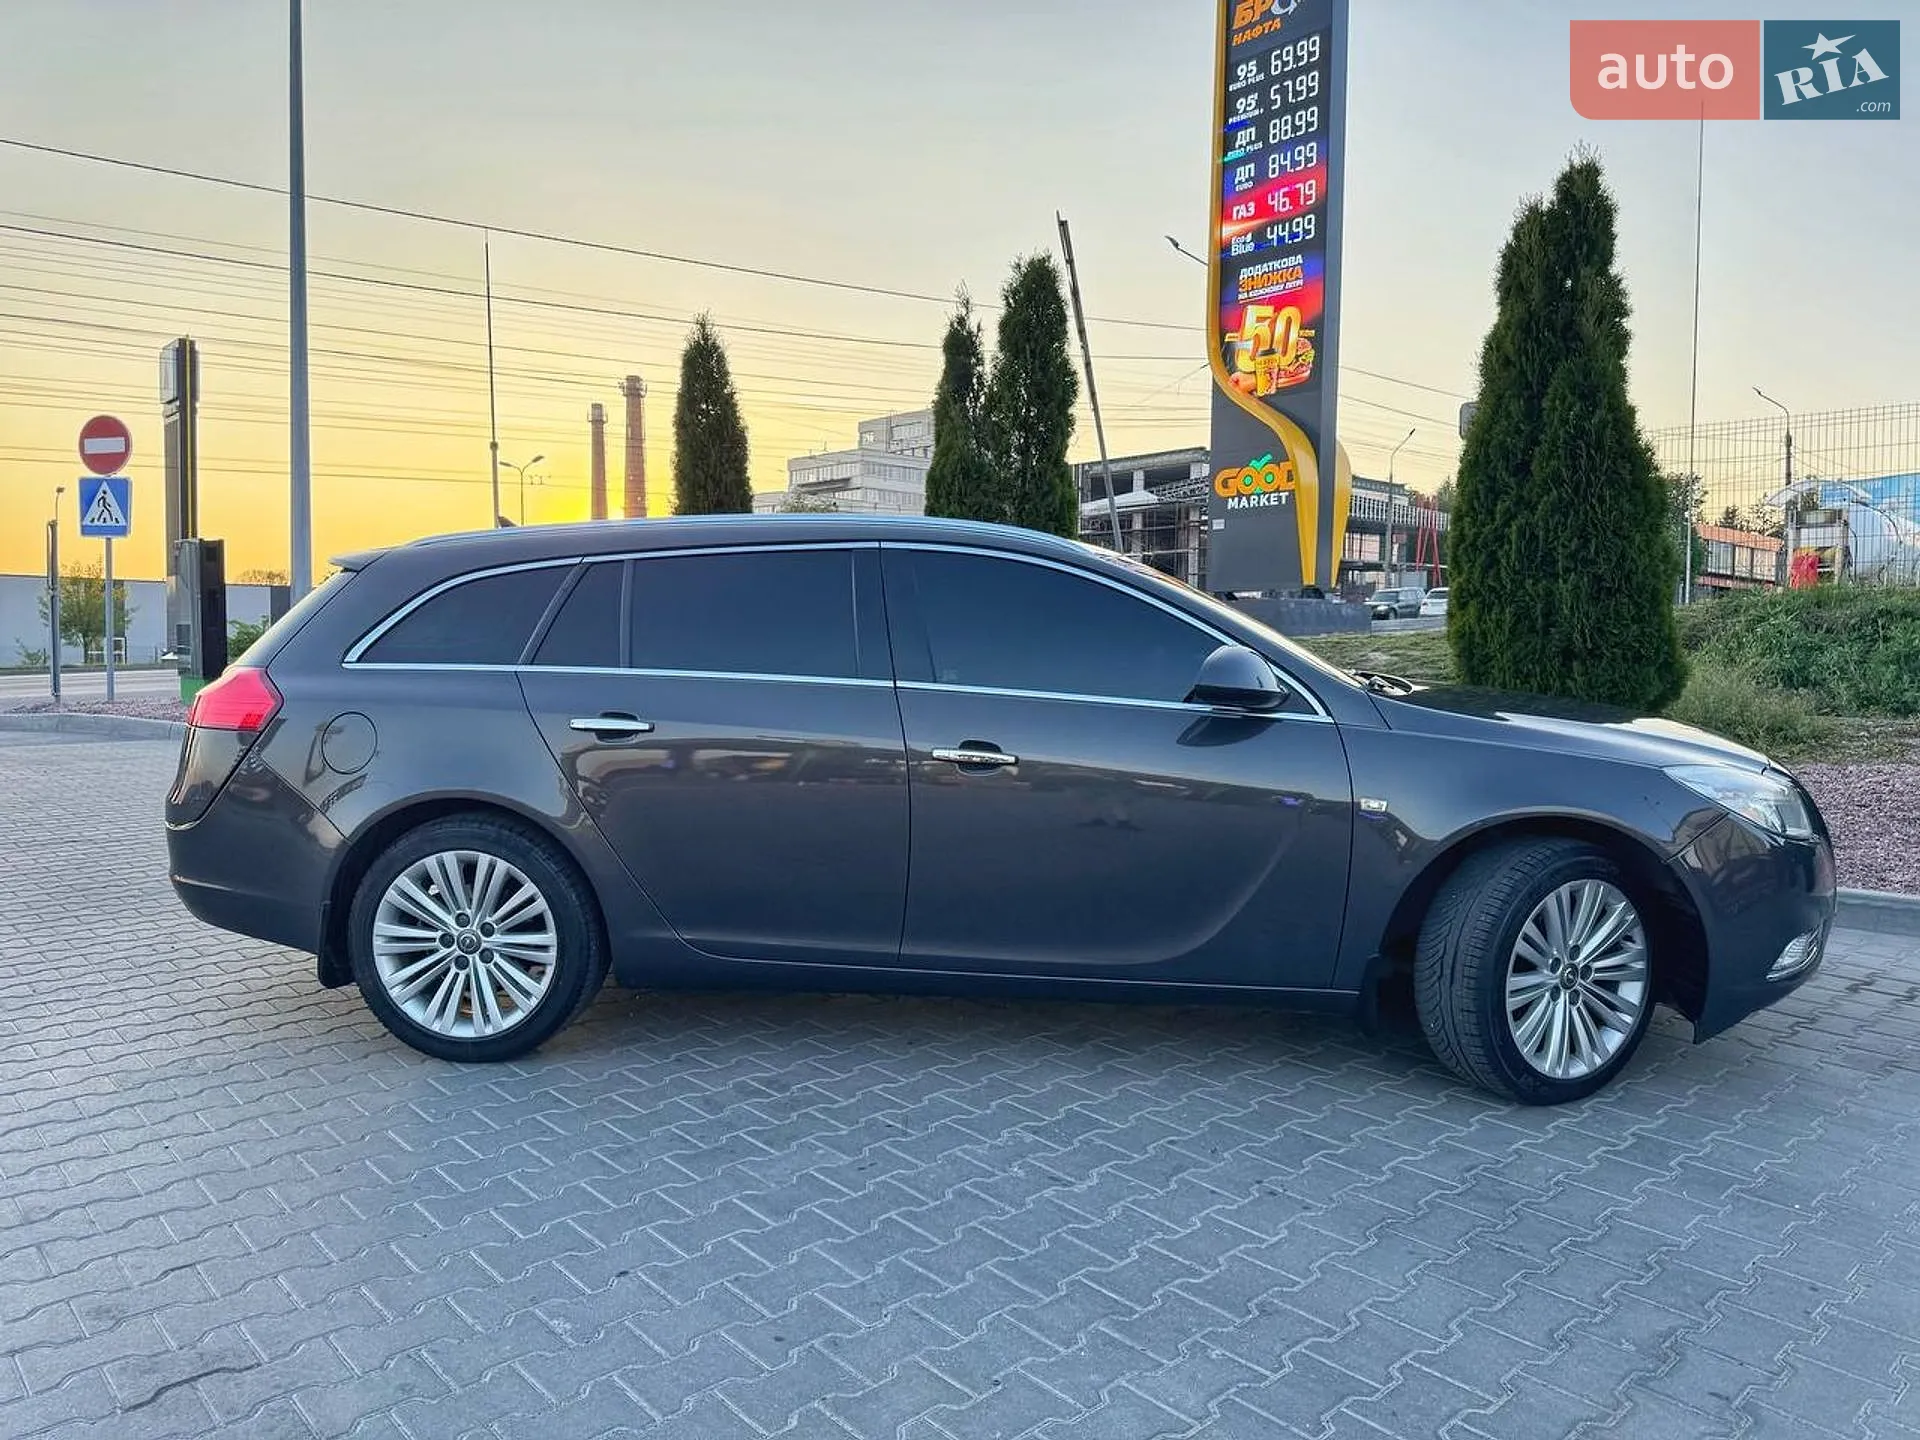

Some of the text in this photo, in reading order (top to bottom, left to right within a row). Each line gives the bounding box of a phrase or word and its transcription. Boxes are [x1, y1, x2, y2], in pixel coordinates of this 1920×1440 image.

[1232, 17, 1282, 46] НАФТА
[1237, 35, 1320, 80] 95 69.99
[1270, 71, 1319, 110] 57.99
[1235, 106, 1318, 149] ДП 88.99
[1234, 142, 1317, 185] ДП 84.99
[1232, 179, 1316, 220] ГАЗ 46.79
[1231, 214, 1316, 256] Blue 44.99
[1238, 266, 1304, 293] ЗНИЖКА
[1239, 254, 1304, 281] ДОДАТКОВА
[1227, 492, 1289, 510] MARKET
